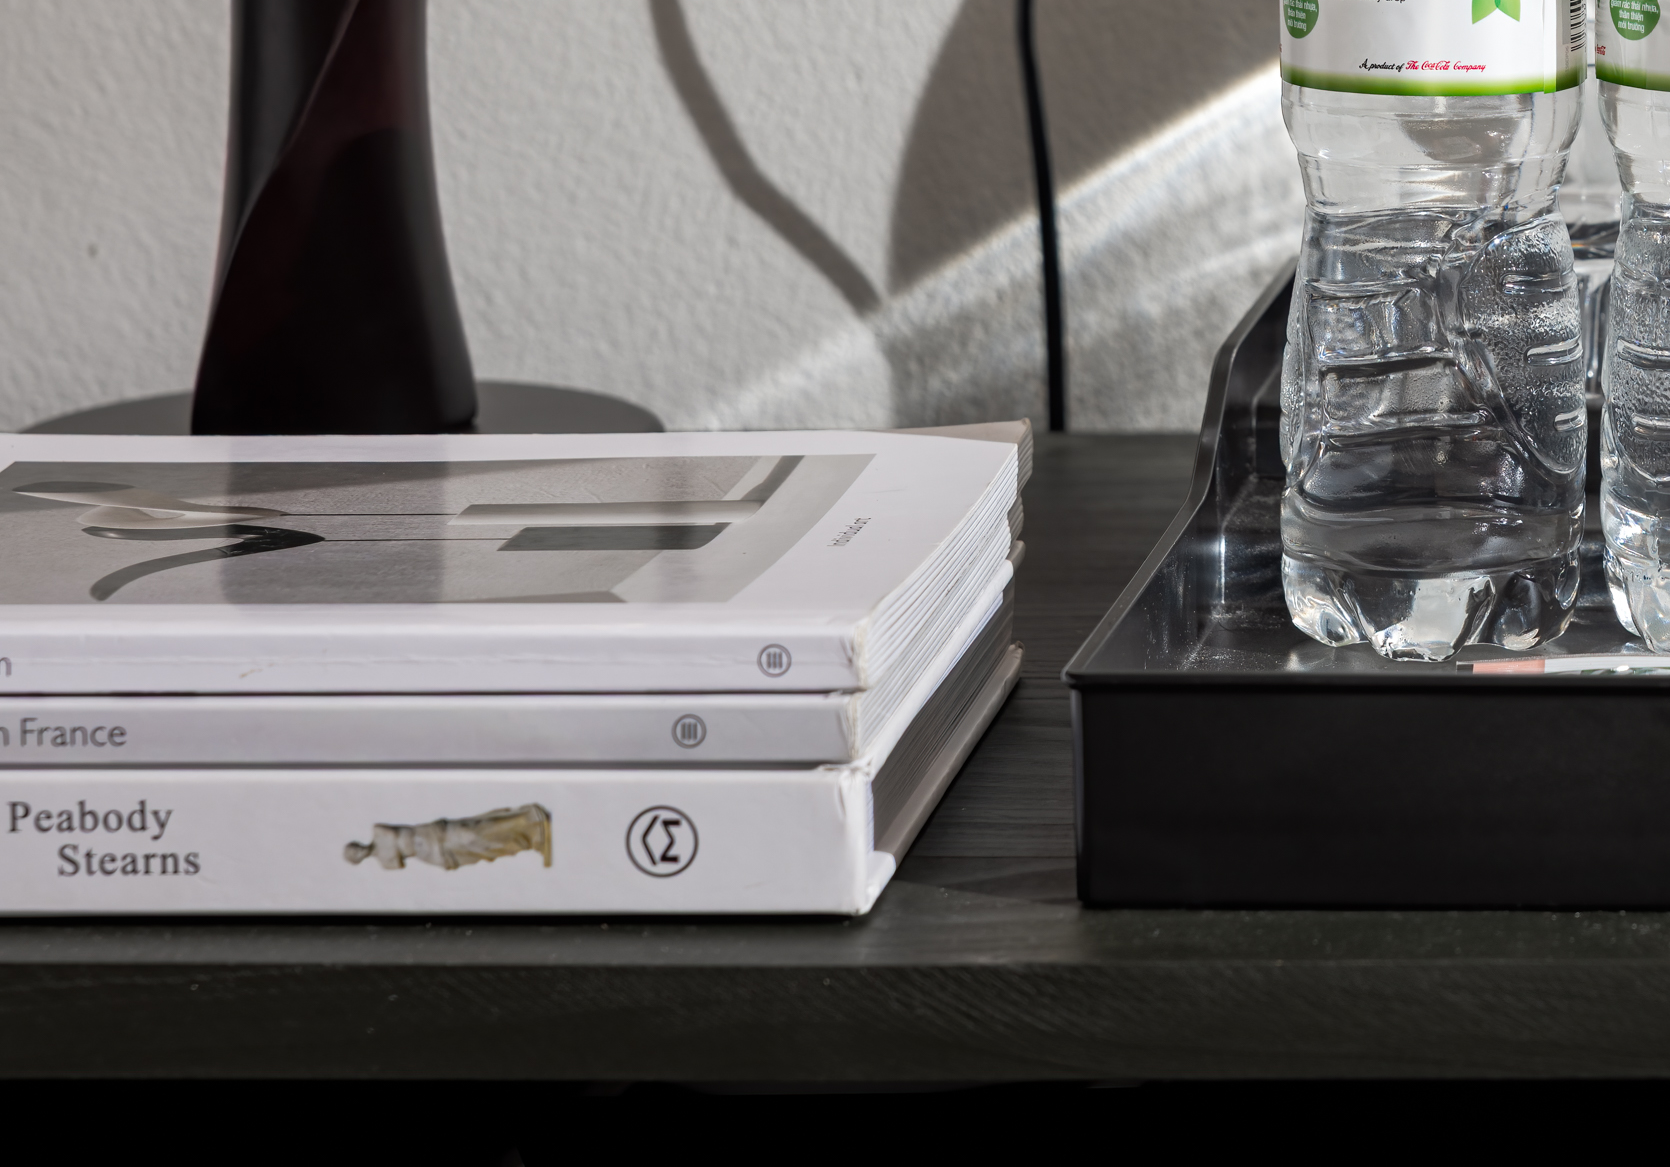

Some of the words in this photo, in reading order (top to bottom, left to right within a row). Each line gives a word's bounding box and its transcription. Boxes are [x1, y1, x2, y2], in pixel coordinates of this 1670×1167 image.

[1359, 58, 1369, 69] A
[1368, 61, 1395, 72] product
[1395, 62, 1405, 73] of
[1405, 60, 1419, 71] The
[1453, 60, 1486, 73] Company
[20, 717, 127, 748] France
[6, 799, 174, 841] Peabody
[57, 843, 201, 877] Stearns
